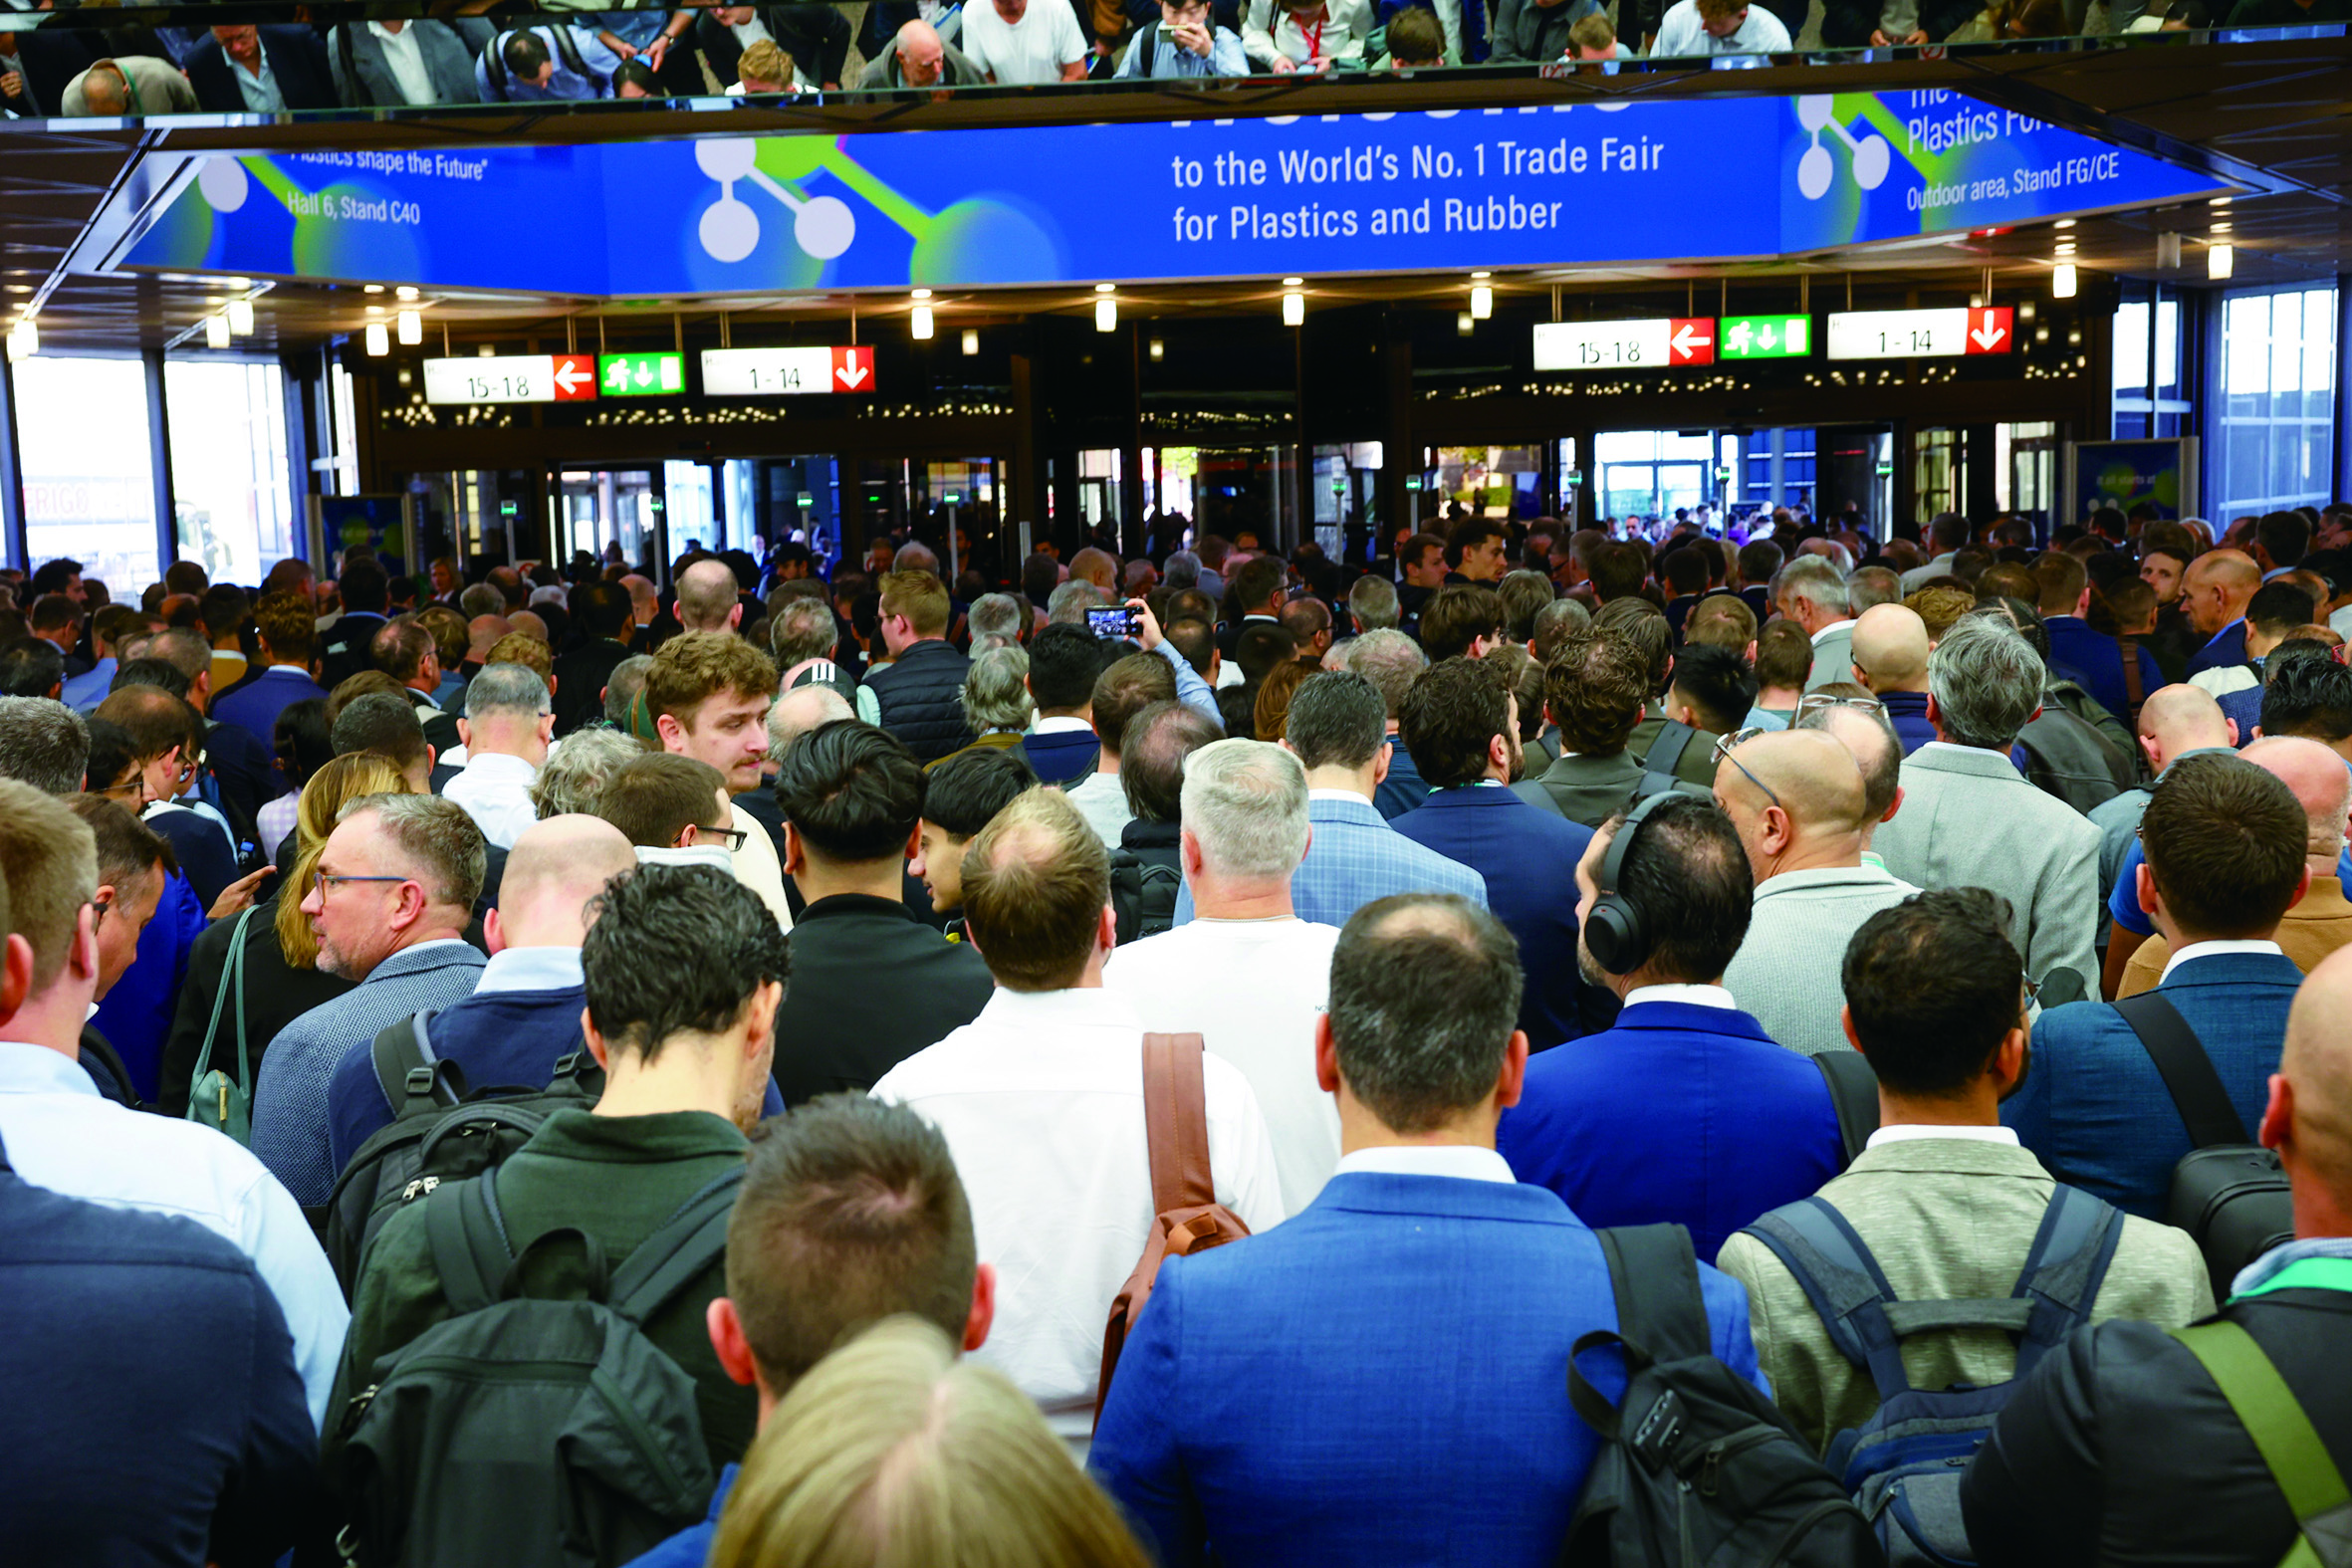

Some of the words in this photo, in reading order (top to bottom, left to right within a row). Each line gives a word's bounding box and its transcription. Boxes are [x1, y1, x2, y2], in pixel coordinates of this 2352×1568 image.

[1908, 107, 1998, 155] Plastics
[356, 151, 404, 175] shape
[407, 150, 432, 175] the
[1171, 156, 1204, 188] to
[1214, 150, 1267, 186] the
[1412, 144, 1463, 179] No.
[1474, 143, 1485, 176] 1
[1498, 137, 1588, 175] Trade
[1601, 135, 1665, 172] Fair
[1907, 183, 1968, 212] Outdoor
[1971, 176, 2010, 200] area,
[2013, 161, 2061, 195] Stand
[2066, 151, 2119, 186] FG/CE
[287, 190, 319, 216] Hall
[323, 194, 339, 221] 6,
[341, 194, 387, 223] Stand
[390, 200, 420, 225] C40
[1173, 206, 1218, 242] for
[1231, 202, 1358, 240] Plastics
[1370, 197, 1430, 235] and
[1445, 194, 1562, 233] Rubber
